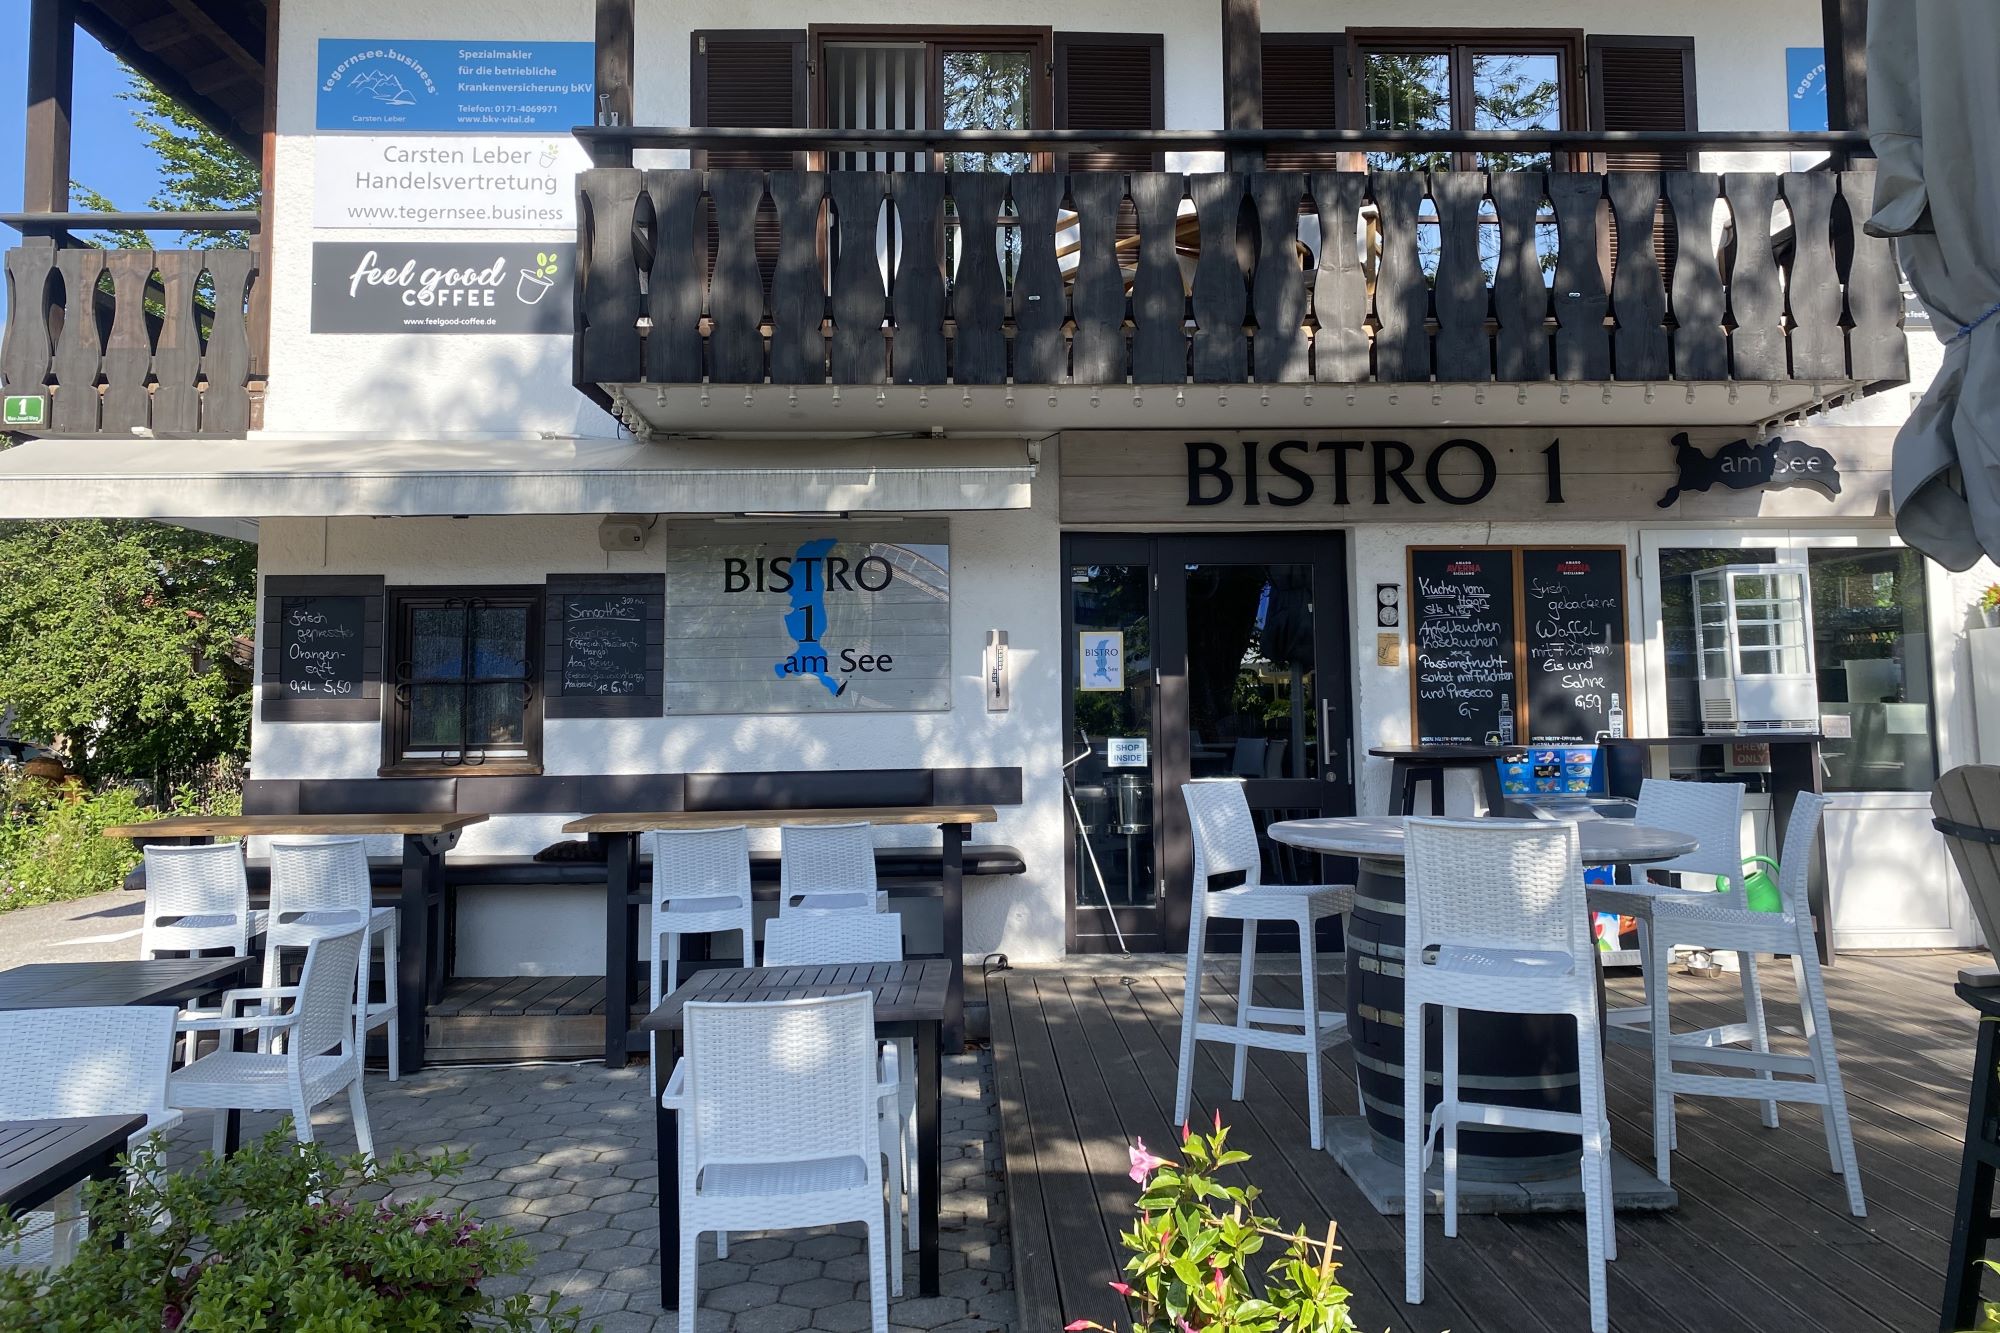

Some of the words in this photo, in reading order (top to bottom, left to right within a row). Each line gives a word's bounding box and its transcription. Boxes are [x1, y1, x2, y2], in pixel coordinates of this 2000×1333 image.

[458, 49, 533, 61] Spezialmakler
[322, 48, 436, 94] tegernsee.business
[458, 66, 474, 75] für
[475, 66, 492, 75] die
[494, 66, 557, 76] betriebliche
[458, 82, 569, 95] Krankenversicherung
[570, 83, 593, 93] bKV
[458, 104, 494, 113] Telefon:
[495, 105, 558, 113] 0171-4069971
[457, 115, 536, 124] www.bkv-vital.de
[383, 145, 464, 164] Carsten
[472, 146, 532, 164] Leber
[355, 171, 558, 195] Handelsvertretung
[347, 205, 563, 222] www.tegernsee.business
[350, 250, 417, 298] feel
[419, 256, 506, 298] good
[402, 289, 495, 306] COFFEE
[403, 317, 497, 326] www.feelgood-coffee.de
[18, 398, 28, 416] 1
[1720, 454, 1762, 473] am
[1773, 451, 1824, 474] See
[1184, 438, 1497, 506] BISTRO
[1541, 437, 1566, 504] 1
[723, 555, 894, 593] BISTRO
[1446, 564, 1482, 573] AVERNA
[1418, 576, 1461, 596] Kuchen
[1462, 583, 1485, 595] vom
[1529, 577, 1570, 599] frisch
[568, 601, 636, 619] Smoothies
[1548, 593, 1616, 620] gebackene
[289, 610, 328, 626] frisch
[798, 604, 818, 643] 1
[1418, 618, 1502, 640] Apfelkuchen
[1535, 620, 1600, 645] Waffel
[289, 643, 346, 667] Orangen-
[1085, 648, 1119, 657] BISTRO
[1531, 642, 1553, 658] mit
[783, 654, 829, 673] am
[839, 648, 893, 673] See
[1543, 658, 1564, 672] Eis
[1567, 657, 1594, 670] und
[1421, 671, 1454, 683] sorbet
[1561, 674, 1606, 689] Sahne
[323, 680, 352, 695] 5,50
[1420, 687, 1446, 699] und
[1446, 682, 1494, 699] Prosecco
[1115, 743, 1140, 751] SHOP
[1735, 743, 1767, 751] CREW
[1113, 754, 1142, 762] INSIDE
[1737, 754, 1766, 764] ONLY
